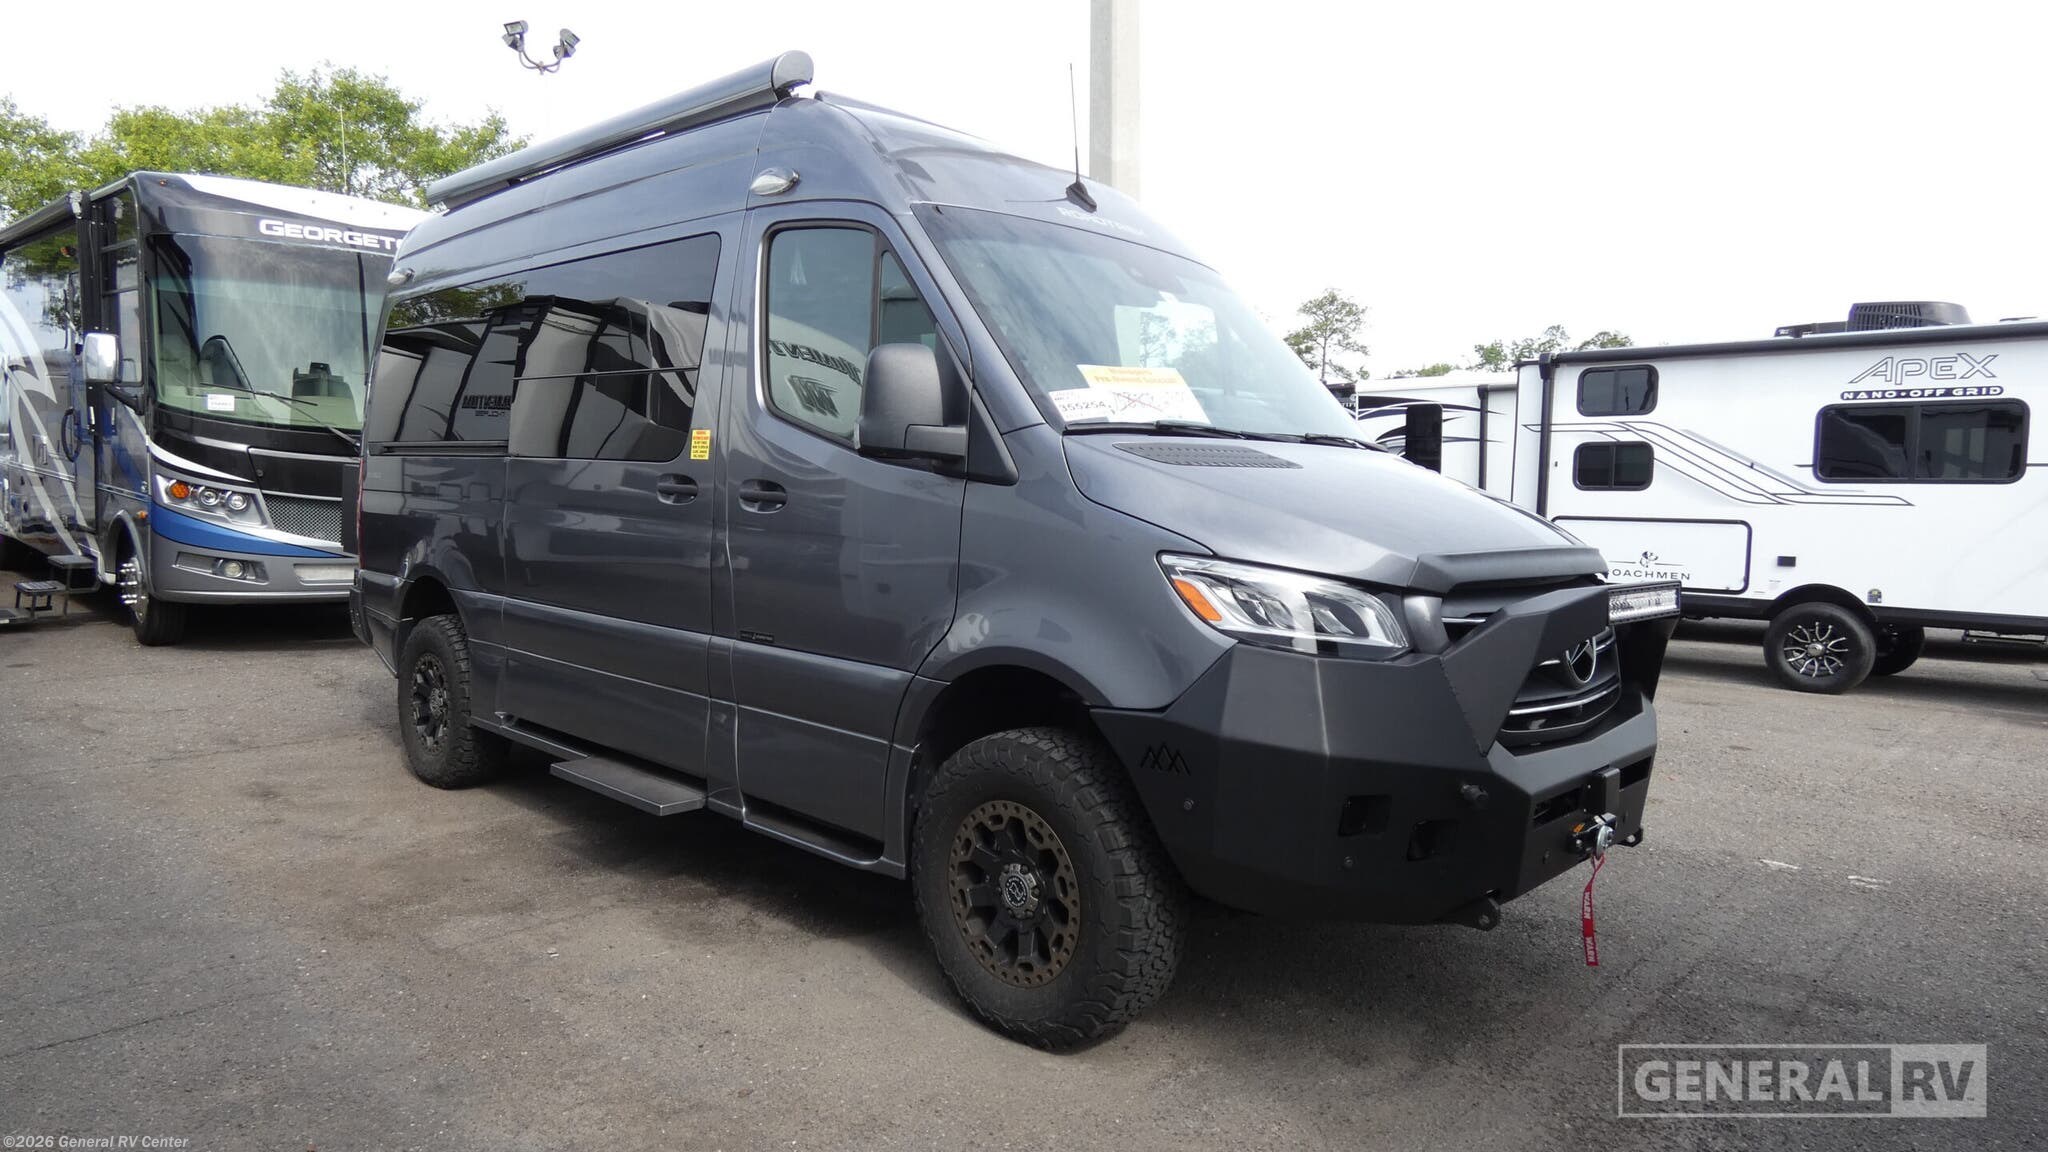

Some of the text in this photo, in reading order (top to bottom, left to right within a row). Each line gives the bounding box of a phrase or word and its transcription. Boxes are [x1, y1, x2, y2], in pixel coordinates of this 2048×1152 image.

[1848, 353, 1999, 385] APEX
[1952, 386, 2000, 396] GRID
[1612, 569, 1691, 580] OACHMEN
[1585, 937, 1595, 962] WARN
